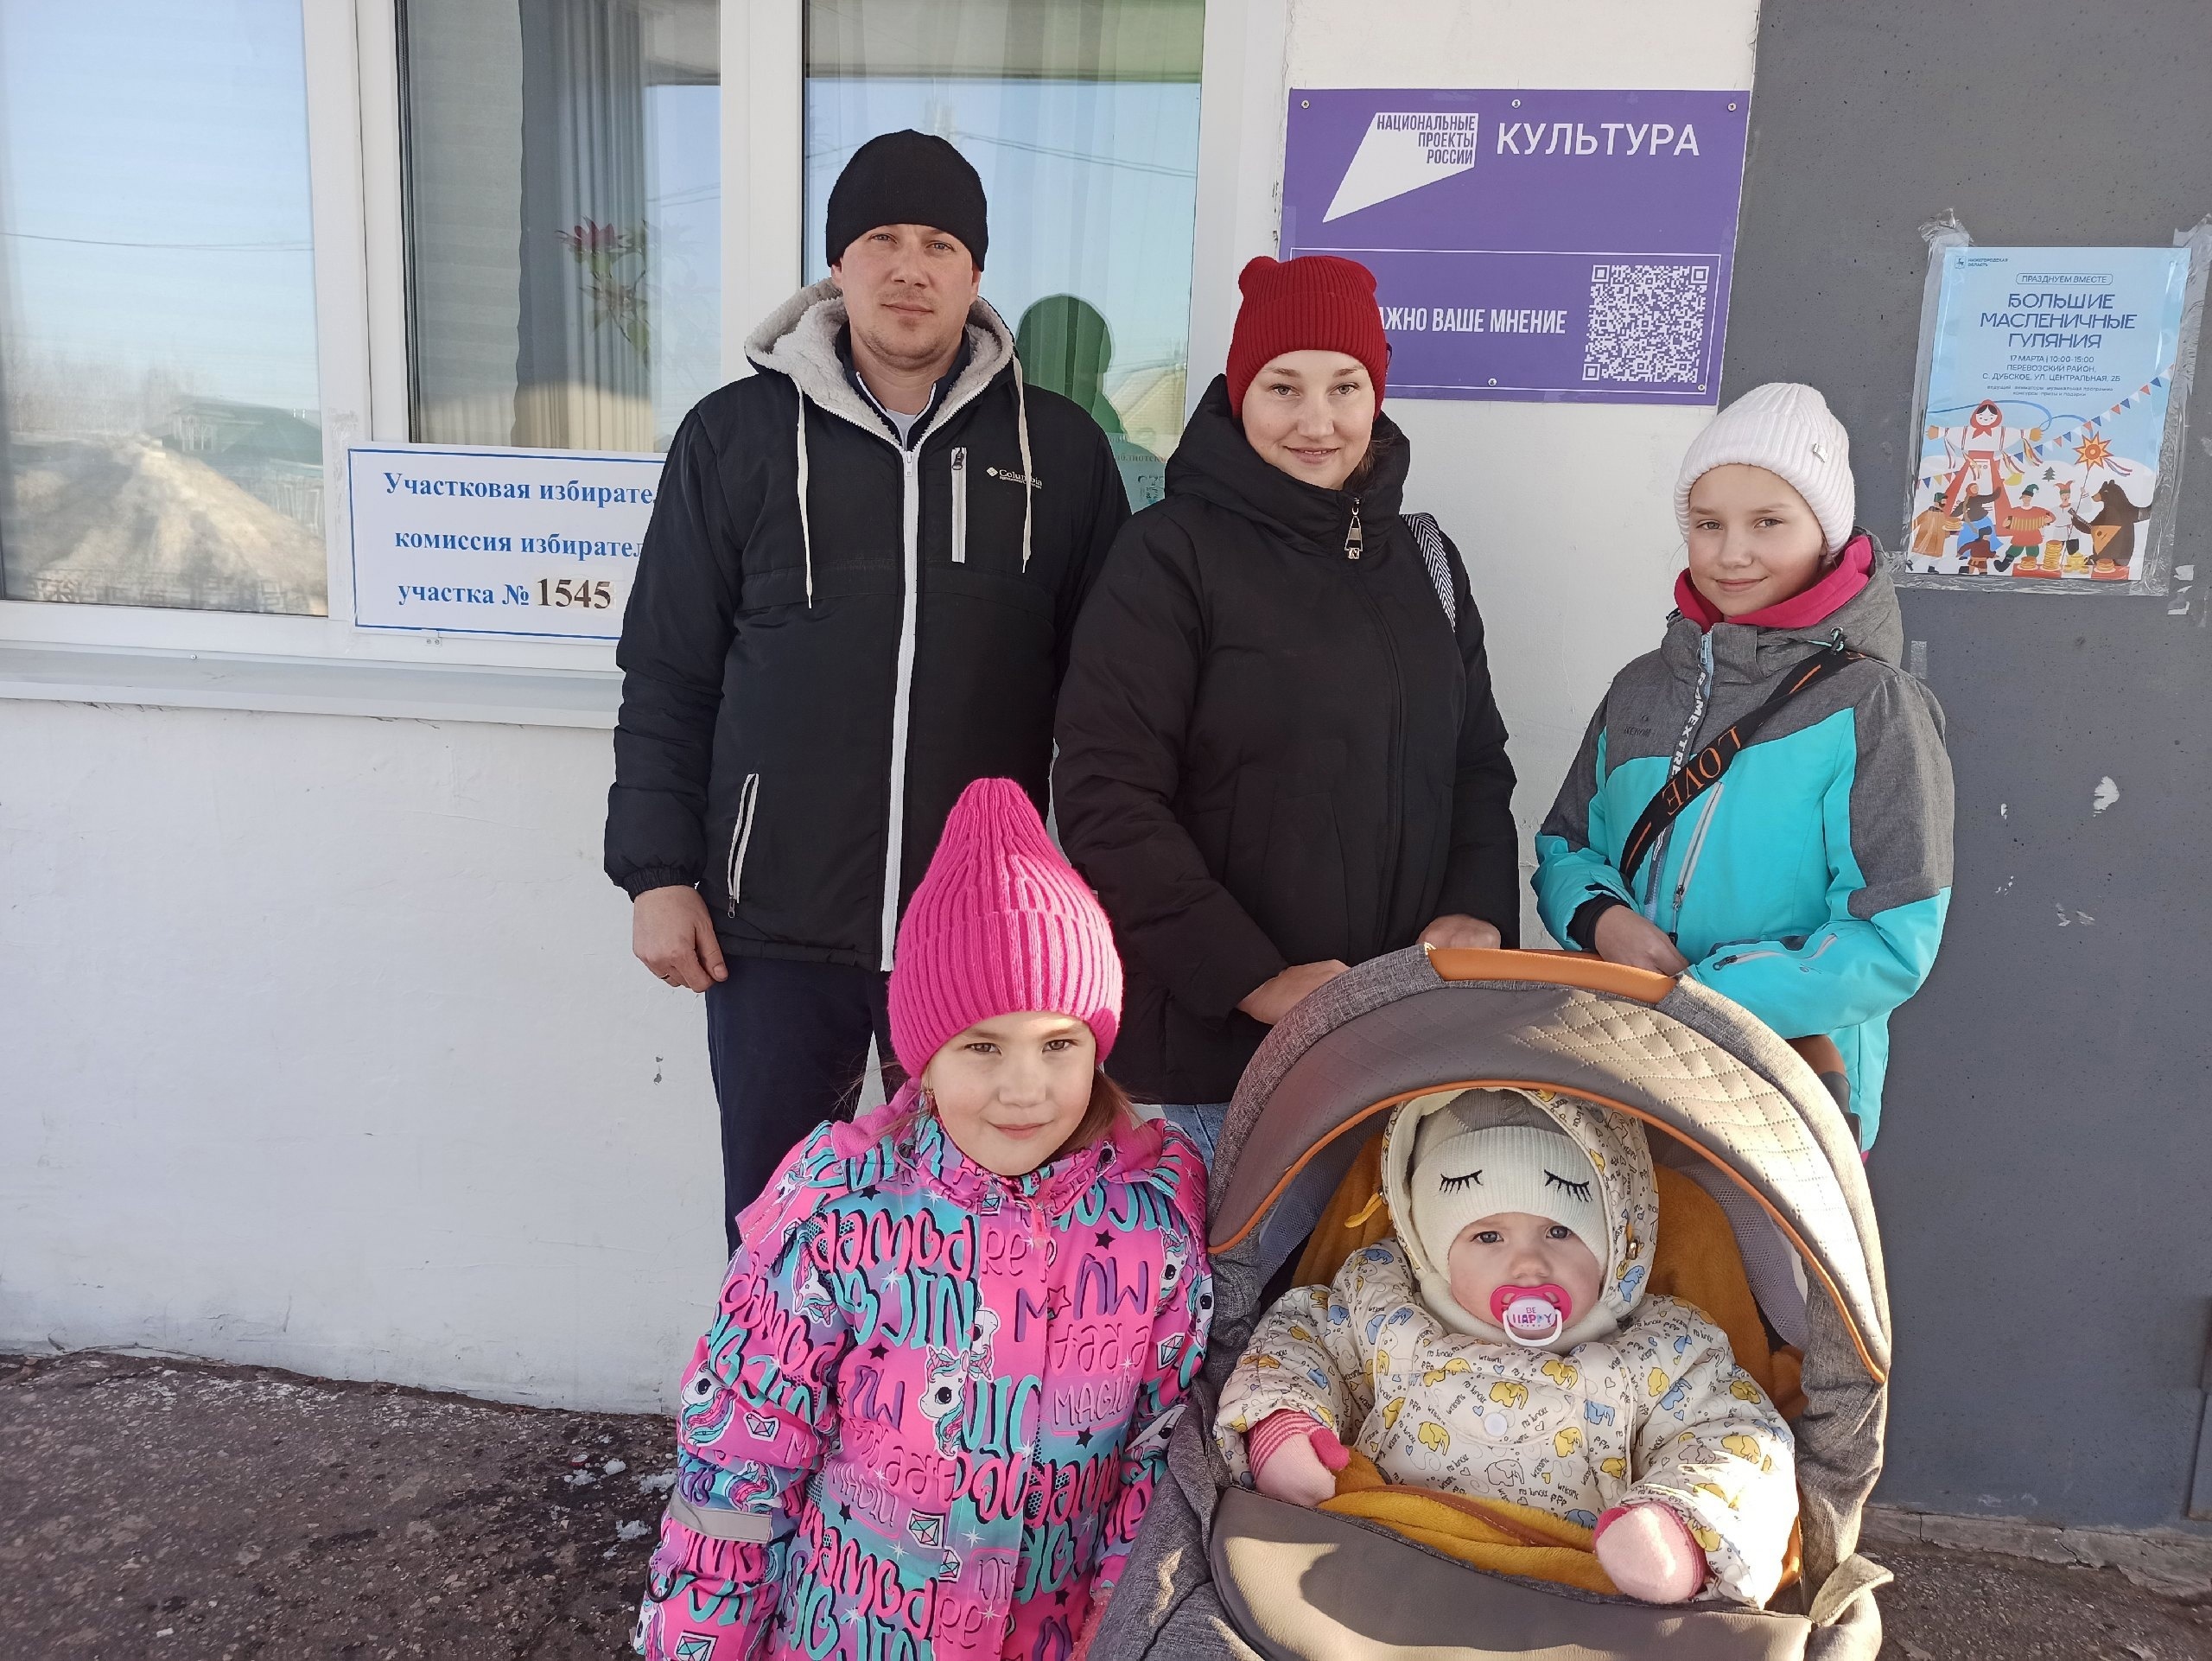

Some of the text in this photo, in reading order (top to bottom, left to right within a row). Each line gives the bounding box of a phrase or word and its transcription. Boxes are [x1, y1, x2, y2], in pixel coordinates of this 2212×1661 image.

[1376, 115, 1476, 131] НАЦИОНАЛЬНЫЕ
[1418, 132, 1474, 148] ПРОЕКТЫ
[1497, 122, 1700, 156] КУЛЬТУРА
[1427, 150, 1473, 164] РОССИИ
[2021, 275, 2072, 283] ПРАЗДНУЕМ
[2007, 293, 2115, 309] БОЛЬШИЕ
[1432, 308, 1485, 332] ВАШЕ
[1490, 309, 1567, 334] МНЕНИЕ
[1980, 312, 2138, 328] МАСЛЕНИЧНЫЕ
[2008, 333, 2102, 348] ГУЛЯНИЯ
[2006, 364, 2065, 372] ПЕРЕВОЗСКИЙ
[384, 472, 656, 508] Участковая избирате
[395, 532, 512, 552] комиссия
[397, 578, 611, 609] участка № 1545
[1662, 725, 1742, 816] LOVE
